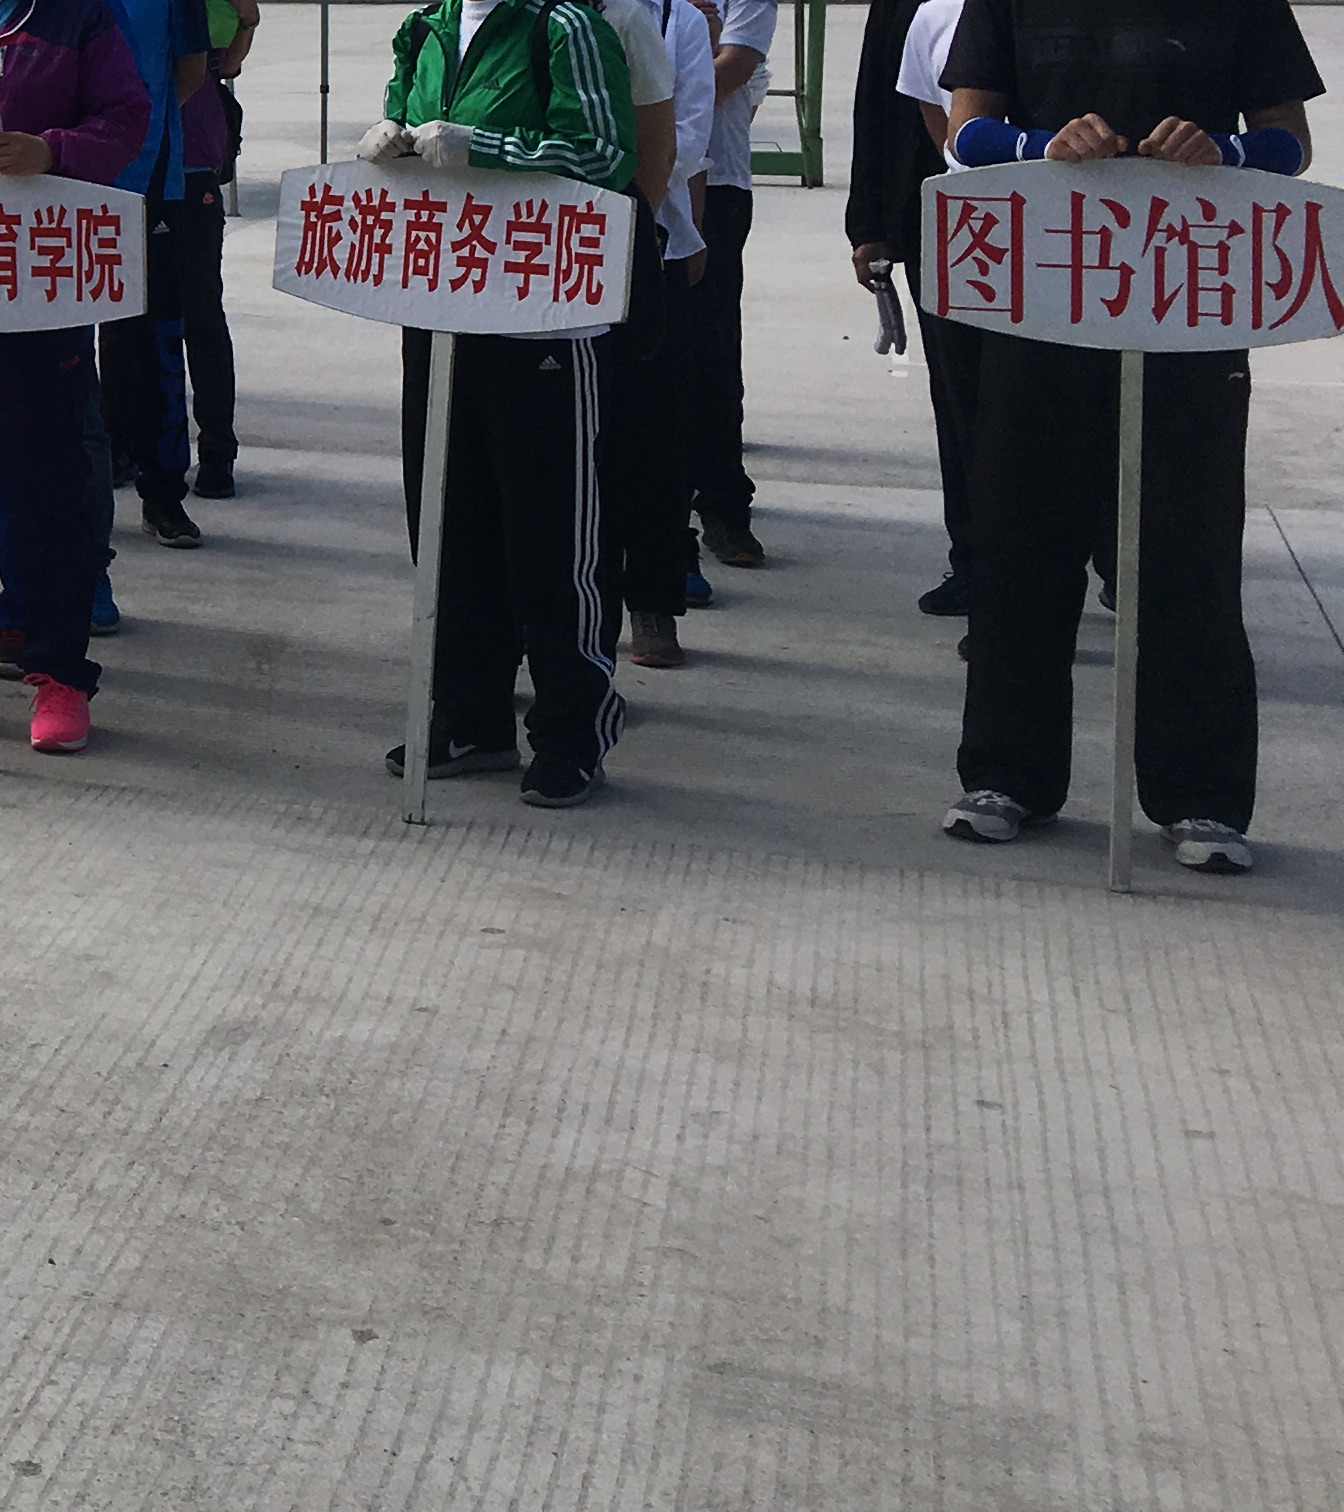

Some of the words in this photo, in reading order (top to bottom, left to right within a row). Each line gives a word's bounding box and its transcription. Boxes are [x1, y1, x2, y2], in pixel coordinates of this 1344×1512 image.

[295, 182, 608, 308] 旅游商务学院
[935, 190, 1344, 331] 图书馆队
